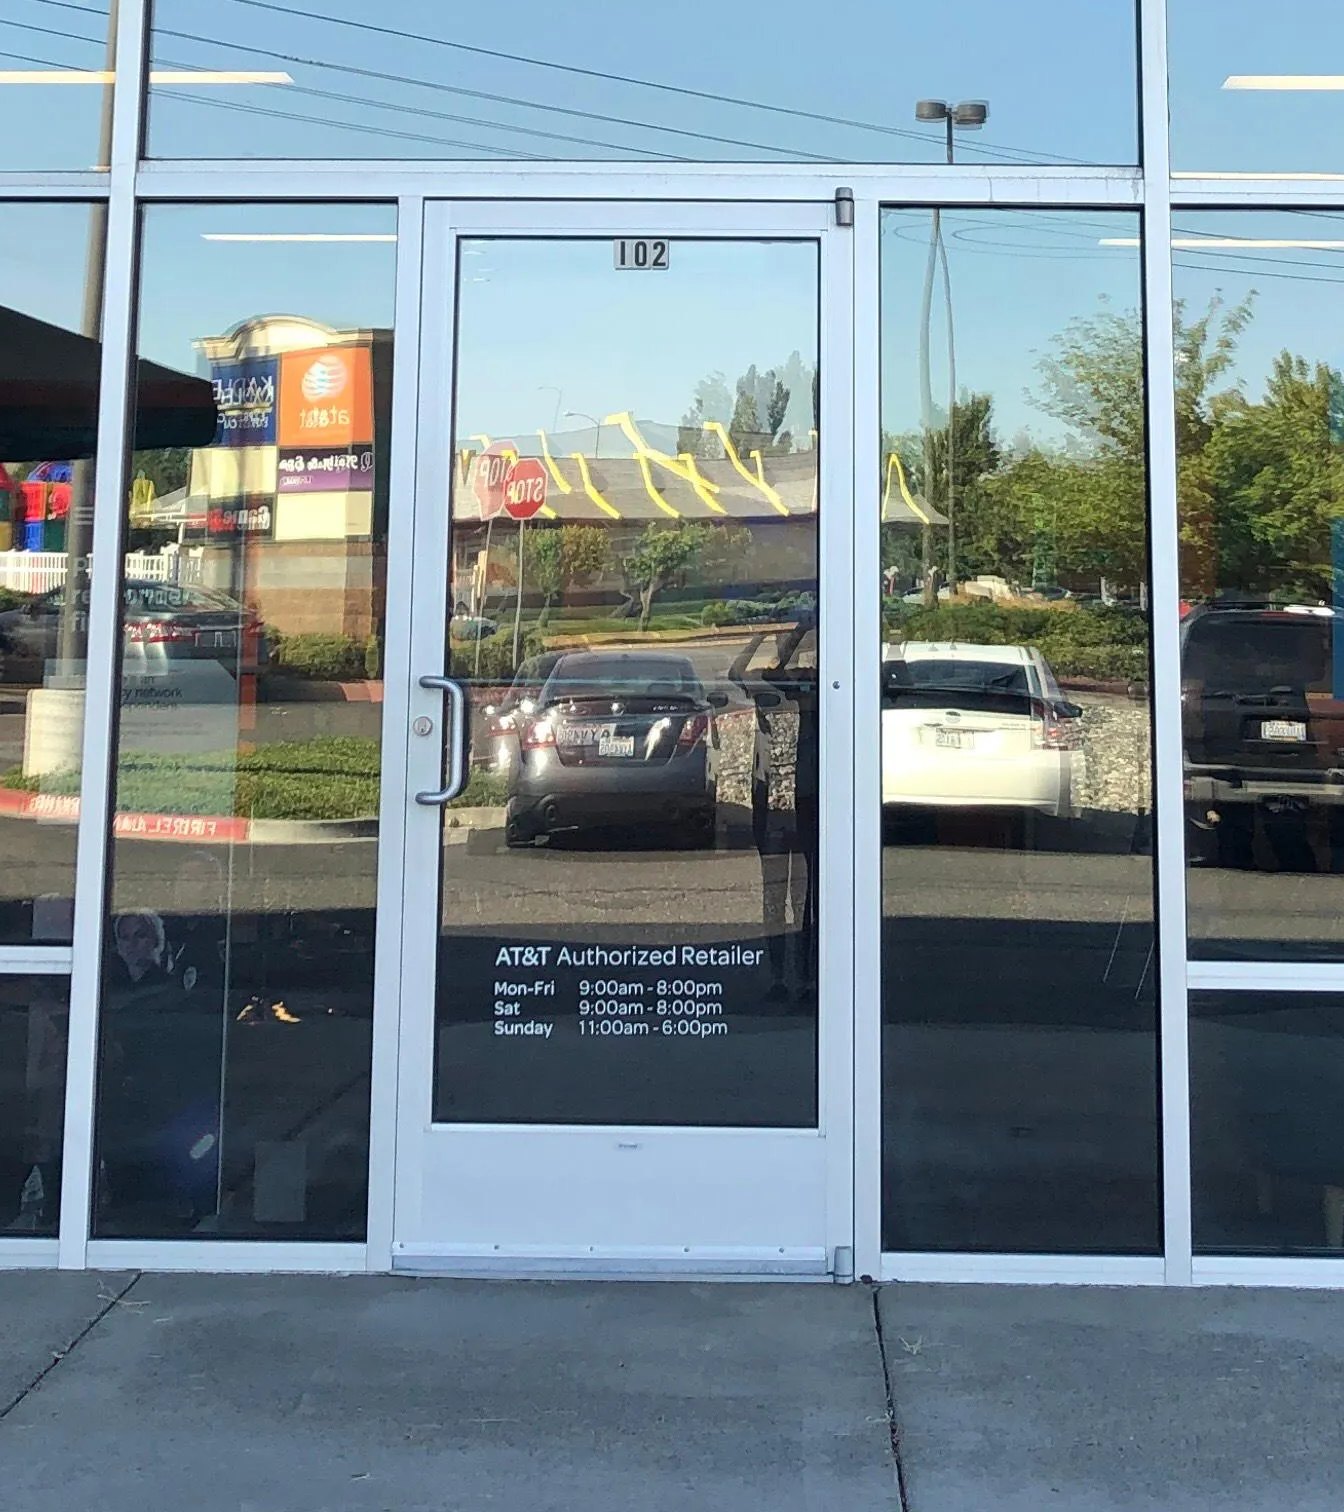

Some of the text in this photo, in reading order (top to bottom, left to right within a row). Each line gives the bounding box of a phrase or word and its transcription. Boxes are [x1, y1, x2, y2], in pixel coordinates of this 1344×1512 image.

[619, 240, 666, 267] 102
[495, 945, 764, 967] AT&T Authorized Retailer
[494, 979, 555, 996] Mon-Fri
[579, 979, 644, 996] 9:00am
[656, 979, 723, 999] 8:00pm
[494, 1000, 521, 1016] Sat
[579, 999, 644, 1016] 9:00am
[656, 999, 723, 1019] 8:00pm
[494, 1019, 554, 1039] Sunday
[579, 1019, 649, 1036] 11:00am
[662, 1019, 728, 1039] 6:00pm
